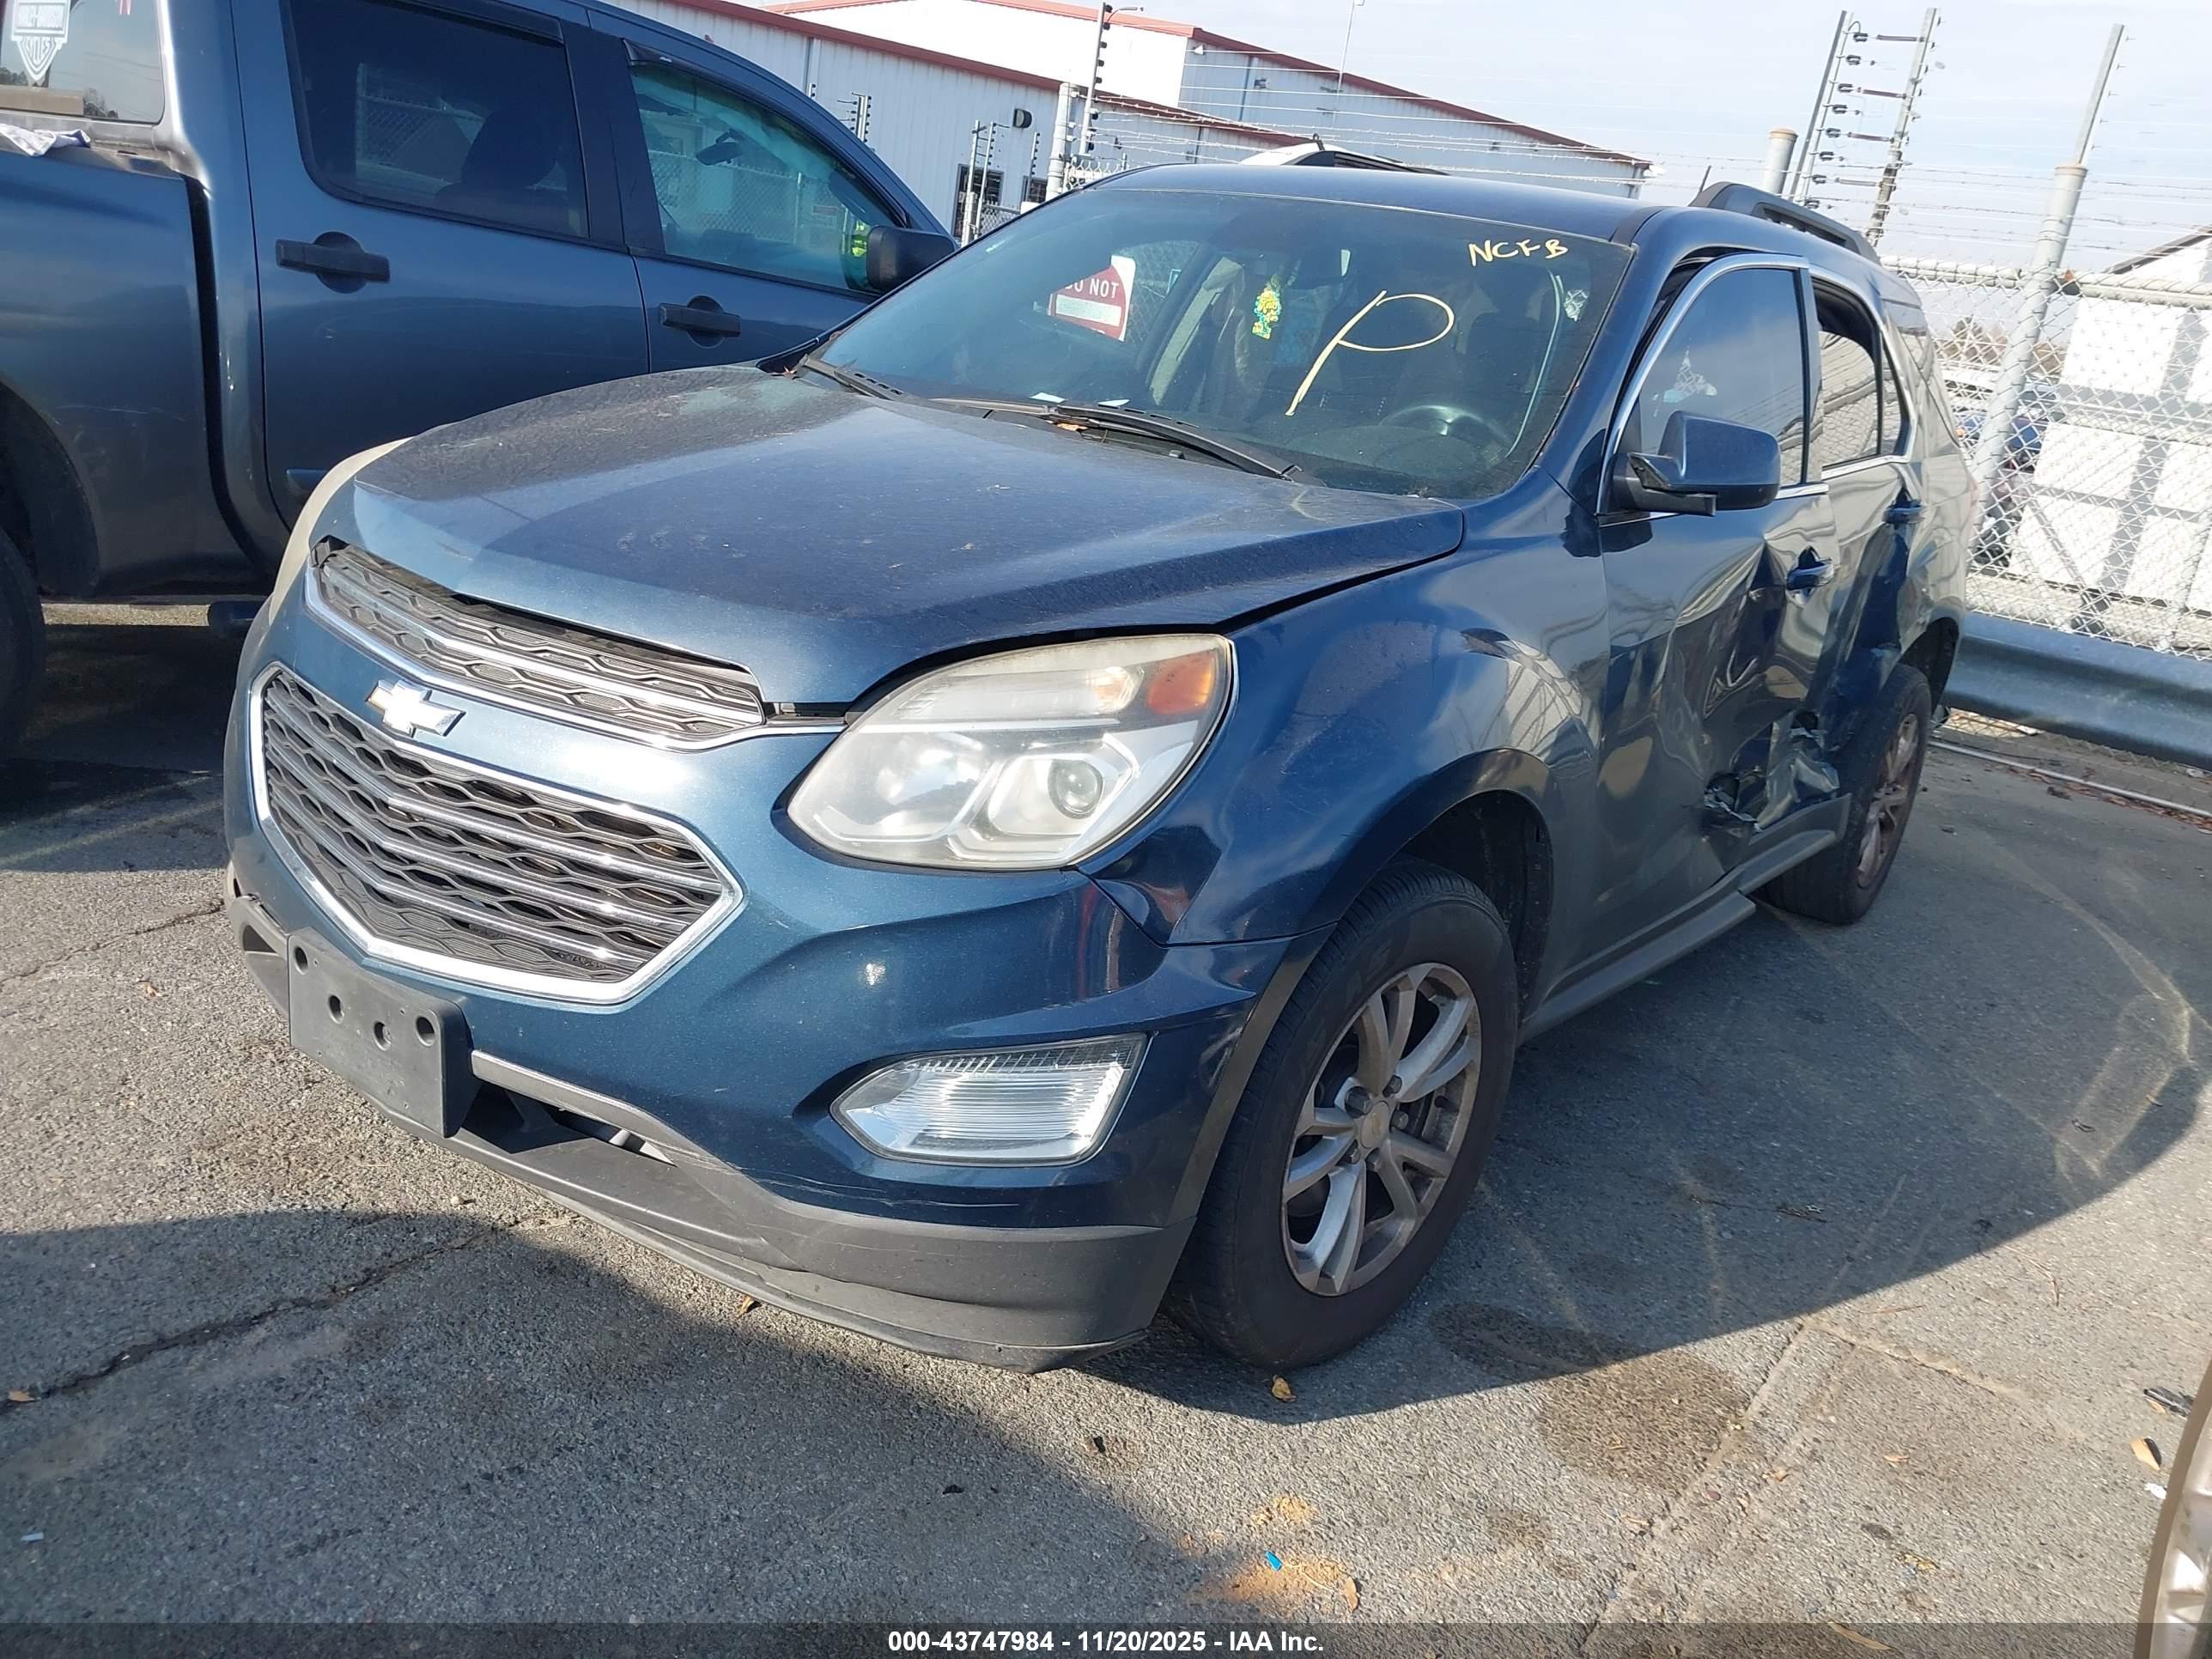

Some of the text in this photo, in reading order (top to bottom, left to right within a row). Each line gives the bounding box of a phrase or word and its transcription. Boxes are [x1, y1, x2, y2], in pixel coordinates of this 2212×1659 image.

[1064, 278, 1120, 299] O NOT
[1285, 289, 1455, 416] P
